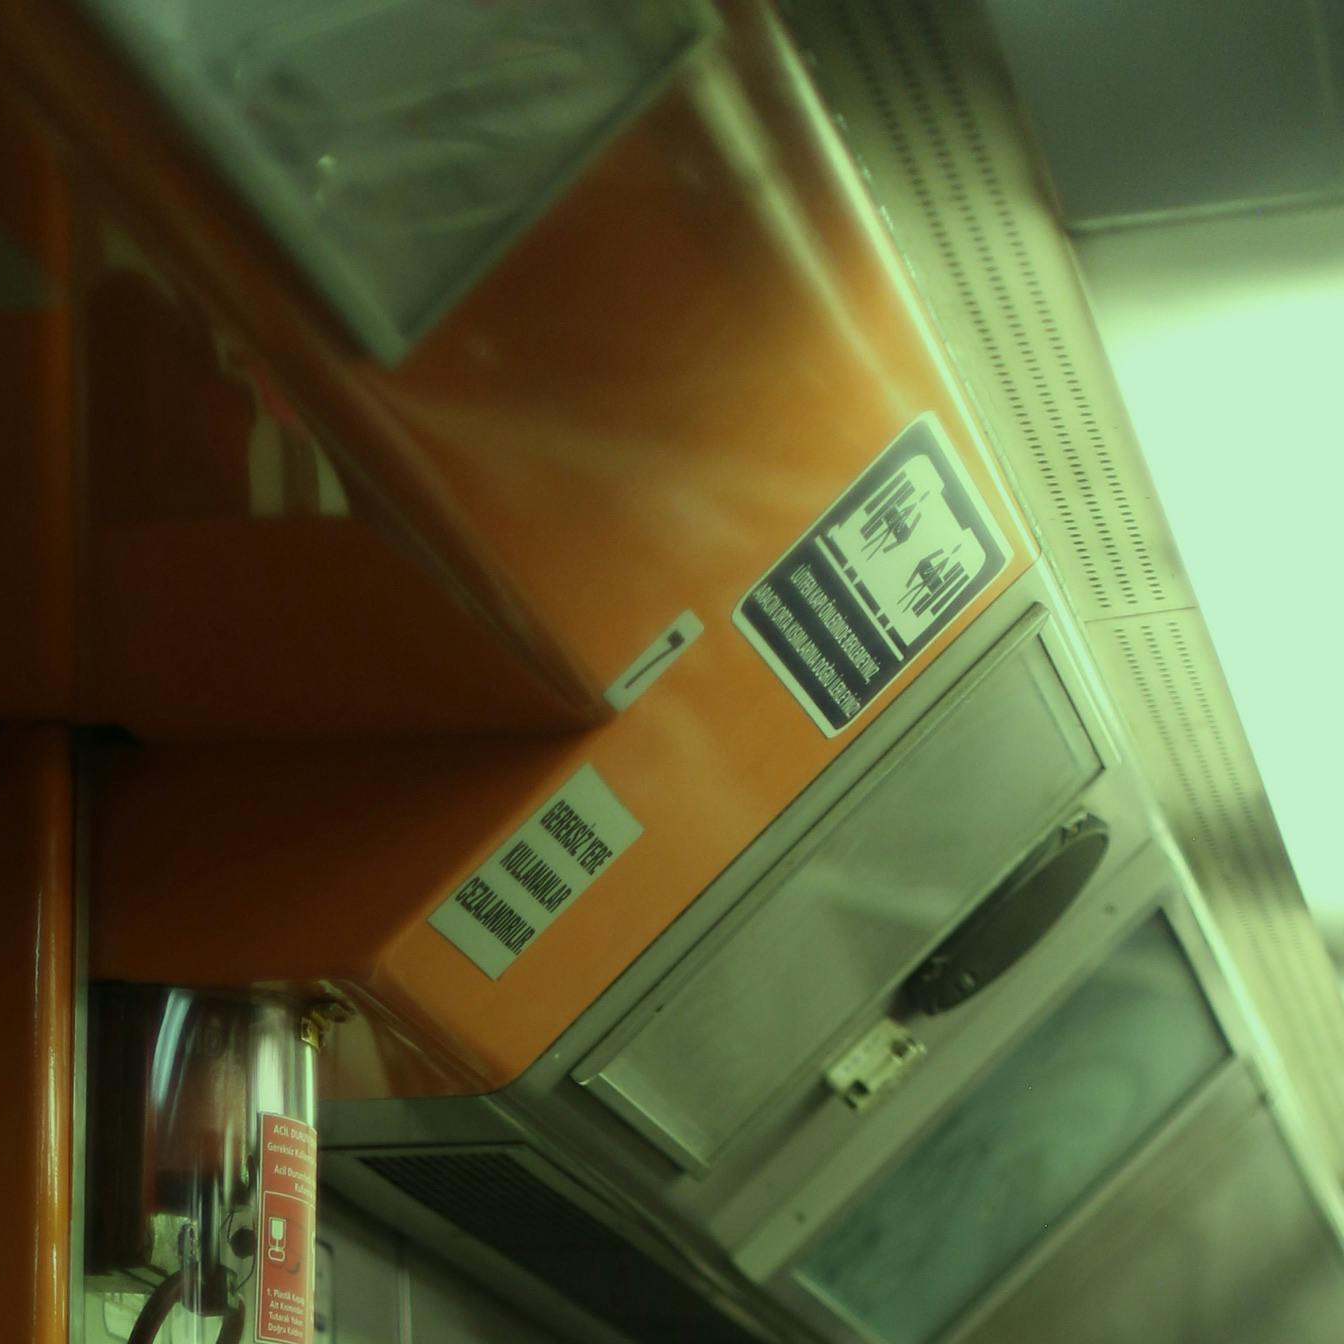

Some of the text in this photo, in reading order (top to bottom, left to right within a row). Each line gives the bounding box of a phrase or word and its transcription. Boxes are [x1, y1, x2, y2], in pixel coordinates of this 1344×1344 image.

[790, 563, 818, 597] LÜTFEN
[806, 586, 828, 612] KAPI
[817, 598, 853, 644] ÖNLERİNDE
[770, 605, 794, 631] ORTA
[811, 657, 838, 687] DOĞRU
[498, 839, 573, 913] KULLANANLAR
[540, 798, 613, 876] GEREKSİZ YERE
